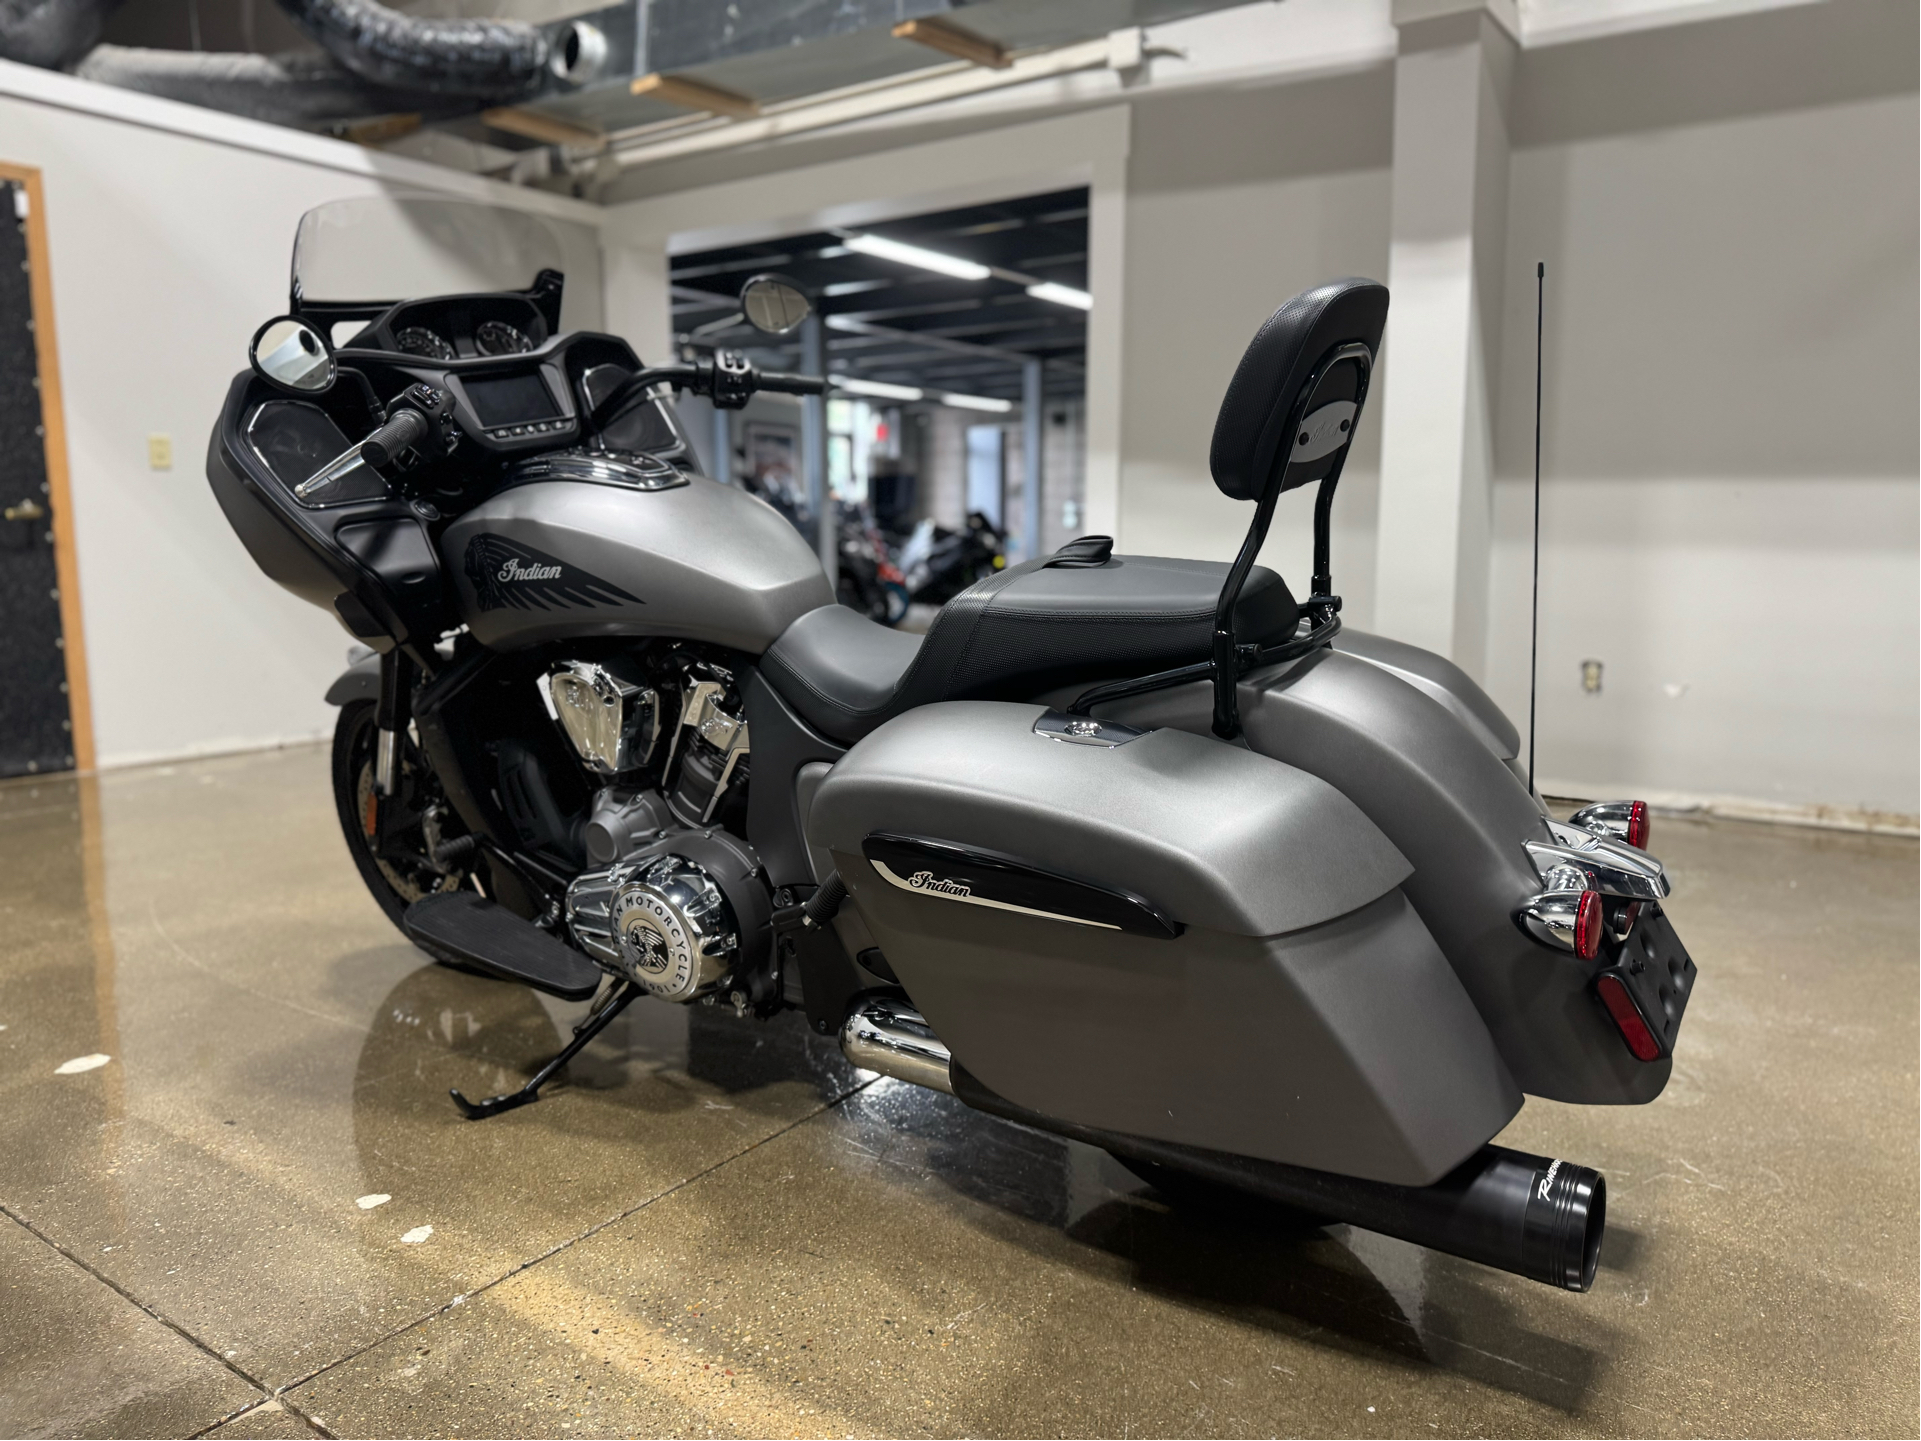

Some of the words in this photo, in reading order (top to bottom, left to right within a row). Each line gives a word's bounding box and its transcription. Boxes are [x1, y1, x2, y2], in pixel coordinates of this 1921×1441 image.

[497, 558, 563, 582] Indian
[908, 871, 971, 898] Indian
[625, 895, 688, 982] MOTORCYCLE
